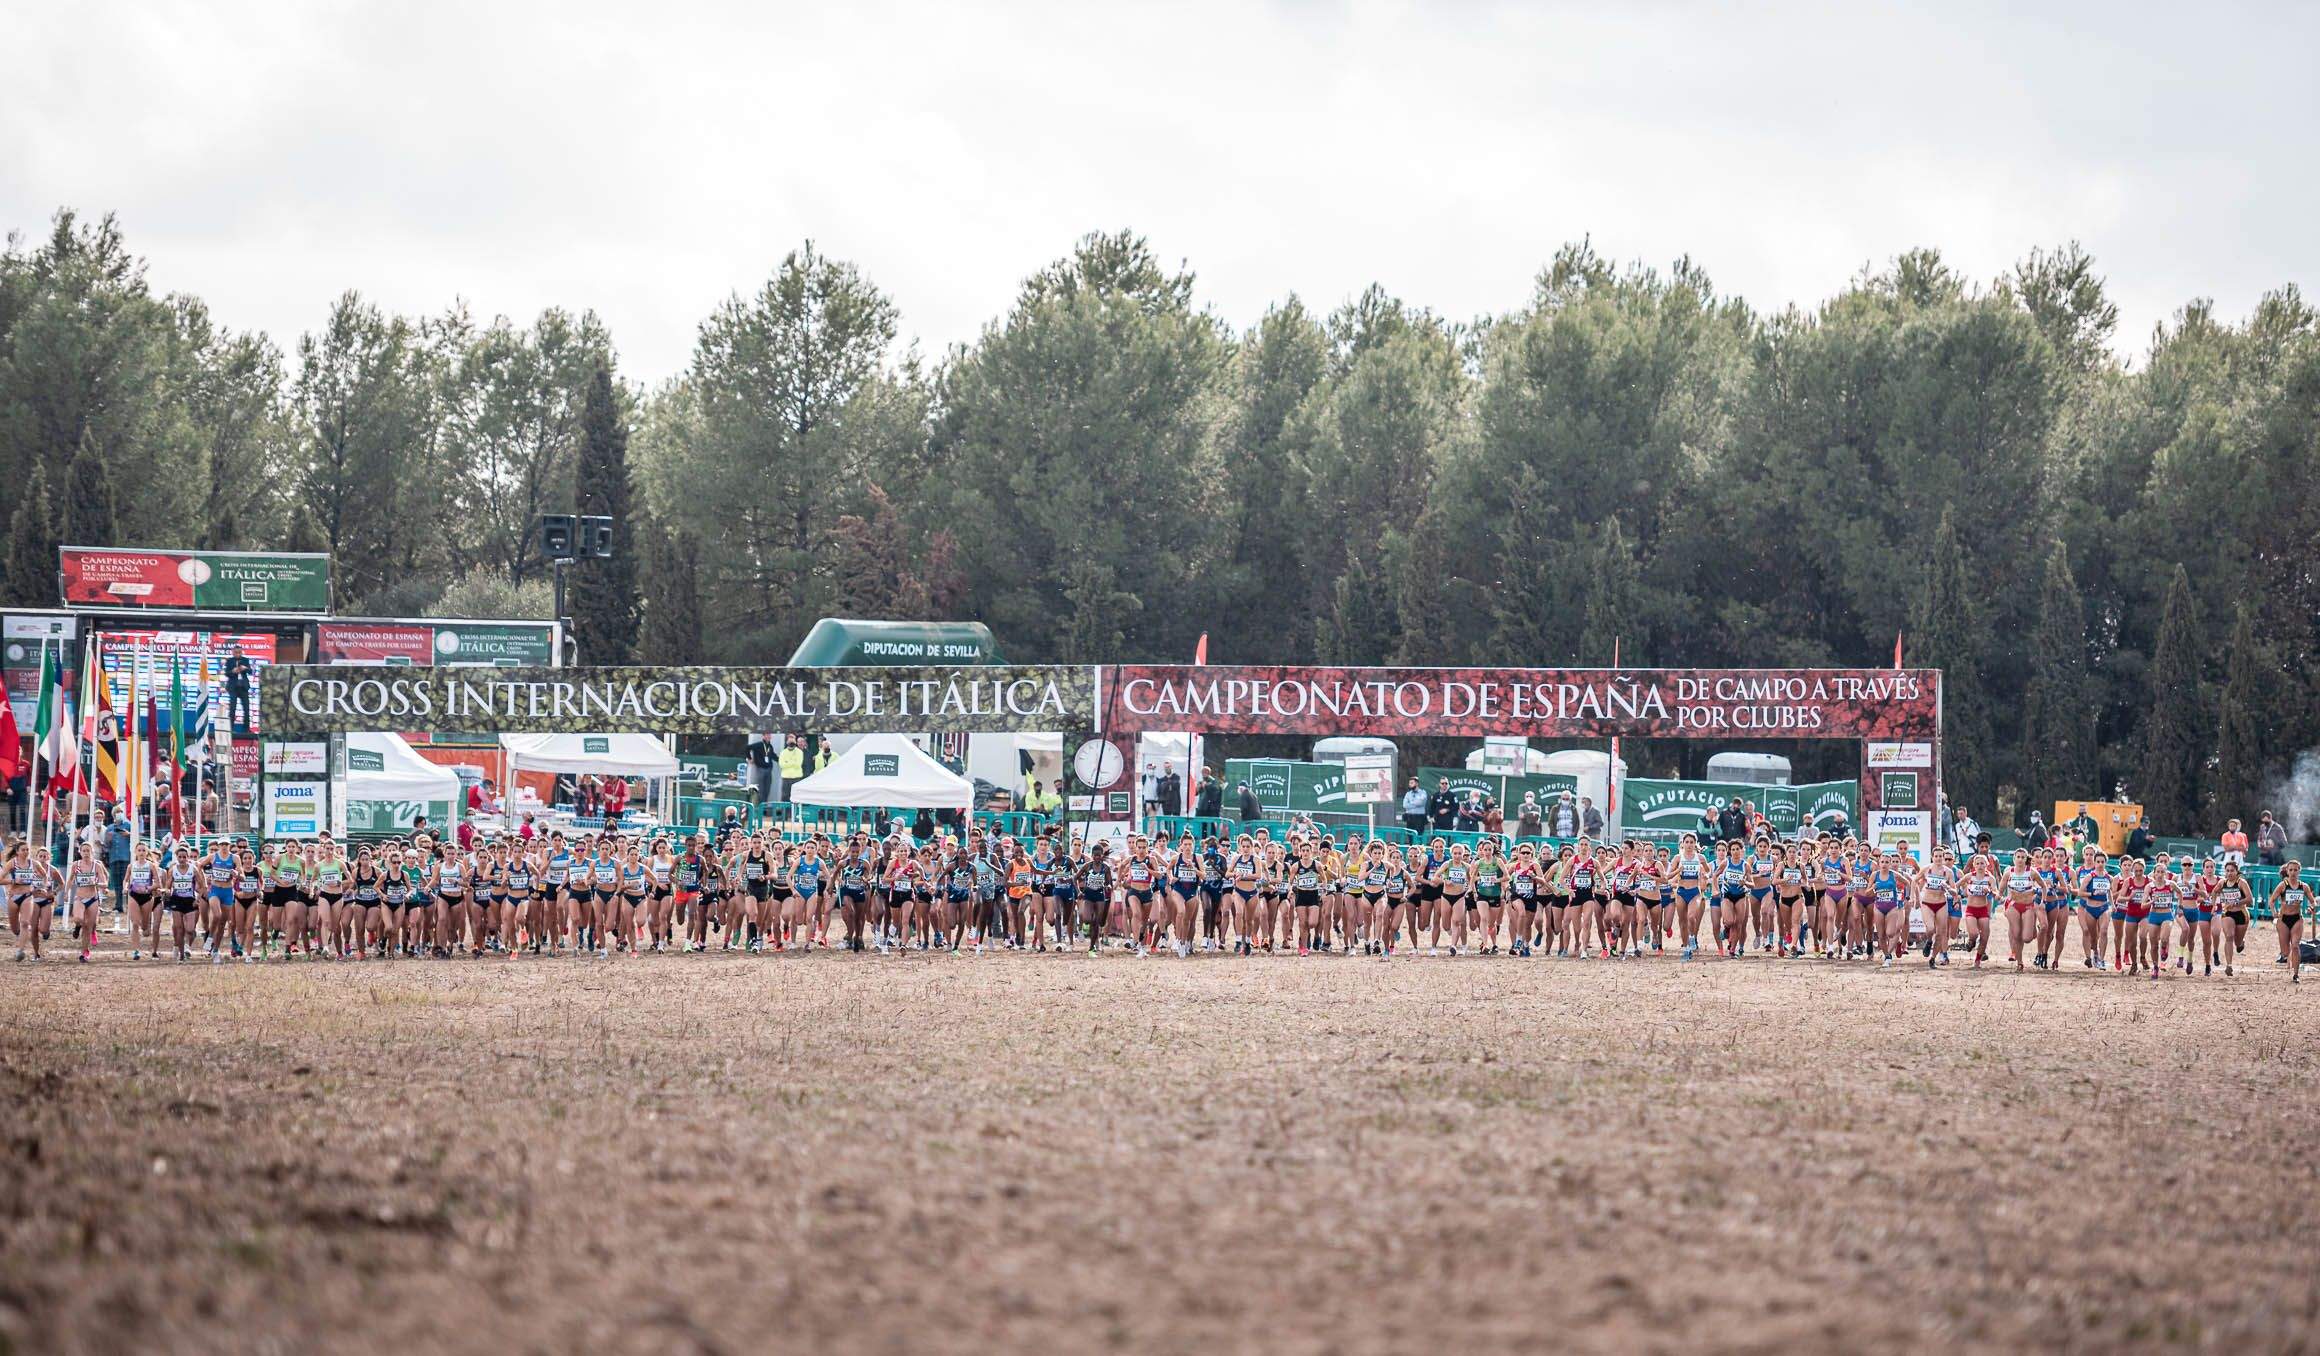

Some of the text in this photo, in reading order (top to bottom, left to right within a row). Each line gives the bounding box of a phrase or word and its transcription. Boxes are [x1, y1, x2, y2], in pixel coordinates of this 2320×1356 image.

[80, 556, 158, 566] CAMPEONATO
[220, 568, 277, 580] ITÁLICA
[325, 631, 424, 641] CAMPEONATO DE ESPAÑA
[460, 640, 506, 653] ITÁLICA
[863, 641, 981, 657] DIPUTACION DE SEVILLA
[291, 671, 1070, 717] CROSS INTERNACIONAL DE ITÁLICA
[1677, 673, 1919, 700] DE CAMPO A TRAVÉS
[1122, 676, 1672, 720] CAMPEONATO DE ESPAÑA
[1677, 705, 1822, 728] POR CLUBES
